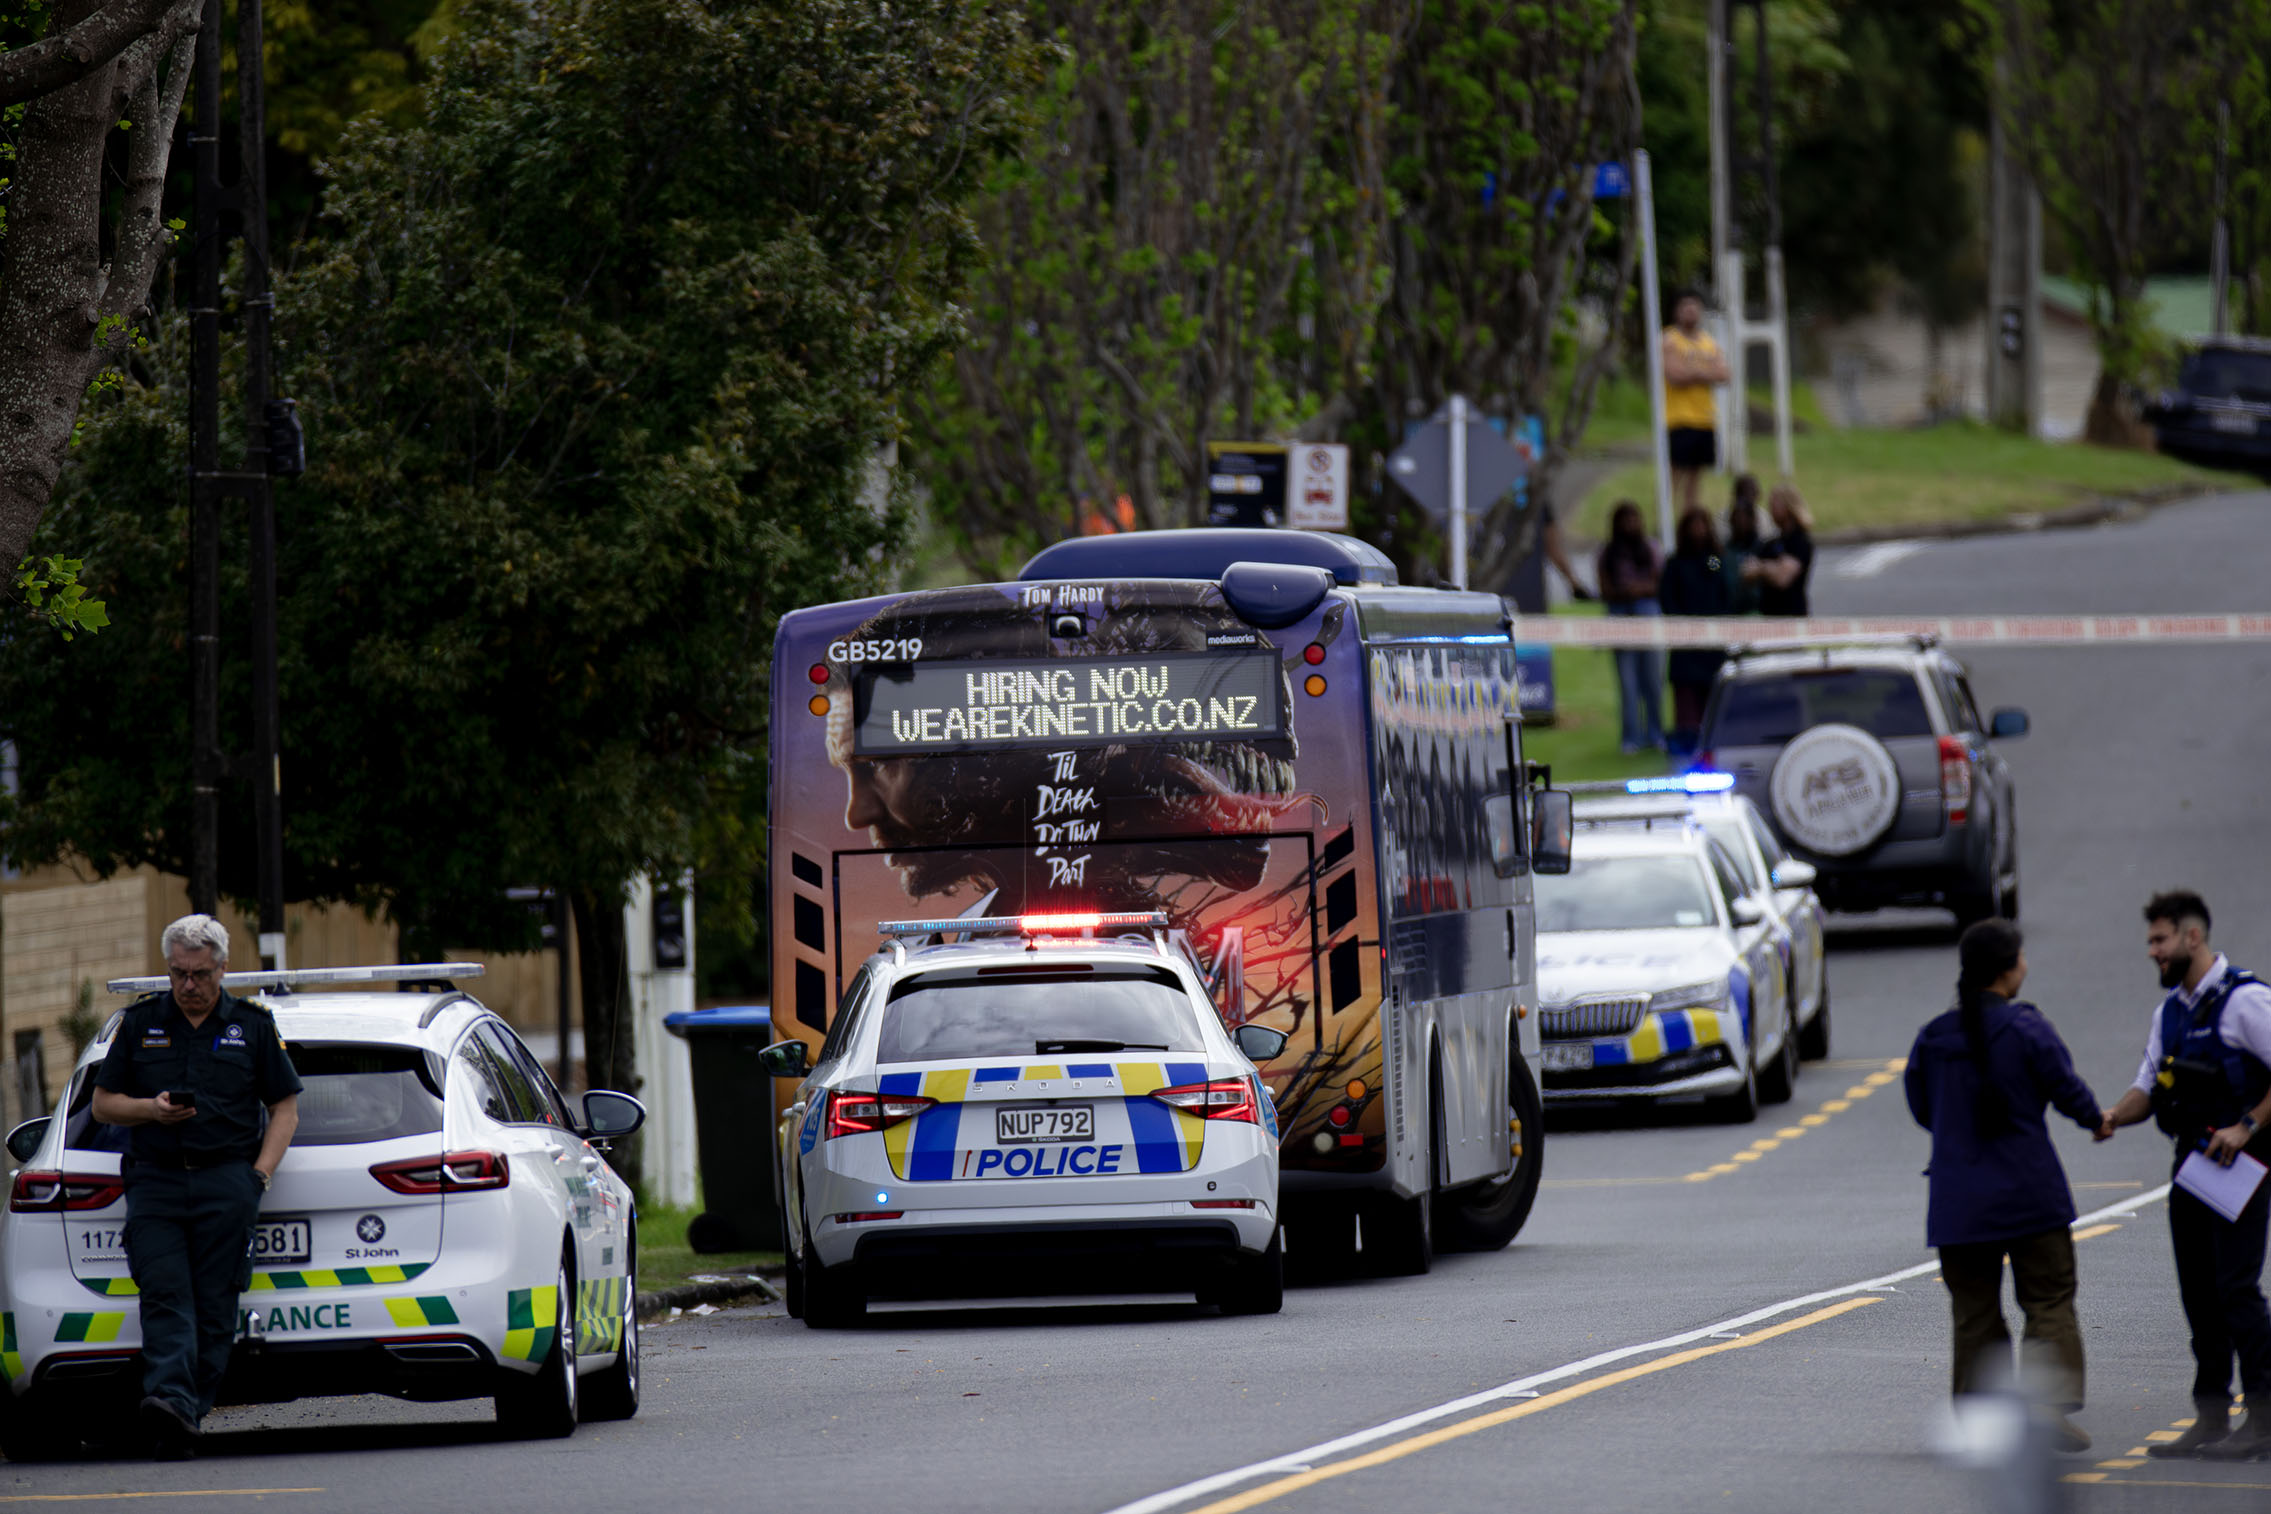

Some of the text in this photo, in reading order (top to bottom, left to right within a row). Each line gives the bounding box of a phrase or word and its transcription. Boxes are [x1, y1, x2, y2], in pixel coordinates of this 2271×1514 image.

[828, 637, 923, 663] GB5219
[1207, 634, 1256, 646] mediaworks
[966, 666, 1168, 706] HIRING NOW
[892, 696, 1258, 742] WEAREKINETIC.CO.NZ
[1001, 1111, 1089, 1136] NUP792
[975, 1144, 1124, 1178] POLICE
[345, 1247, 399, 1259] St John
